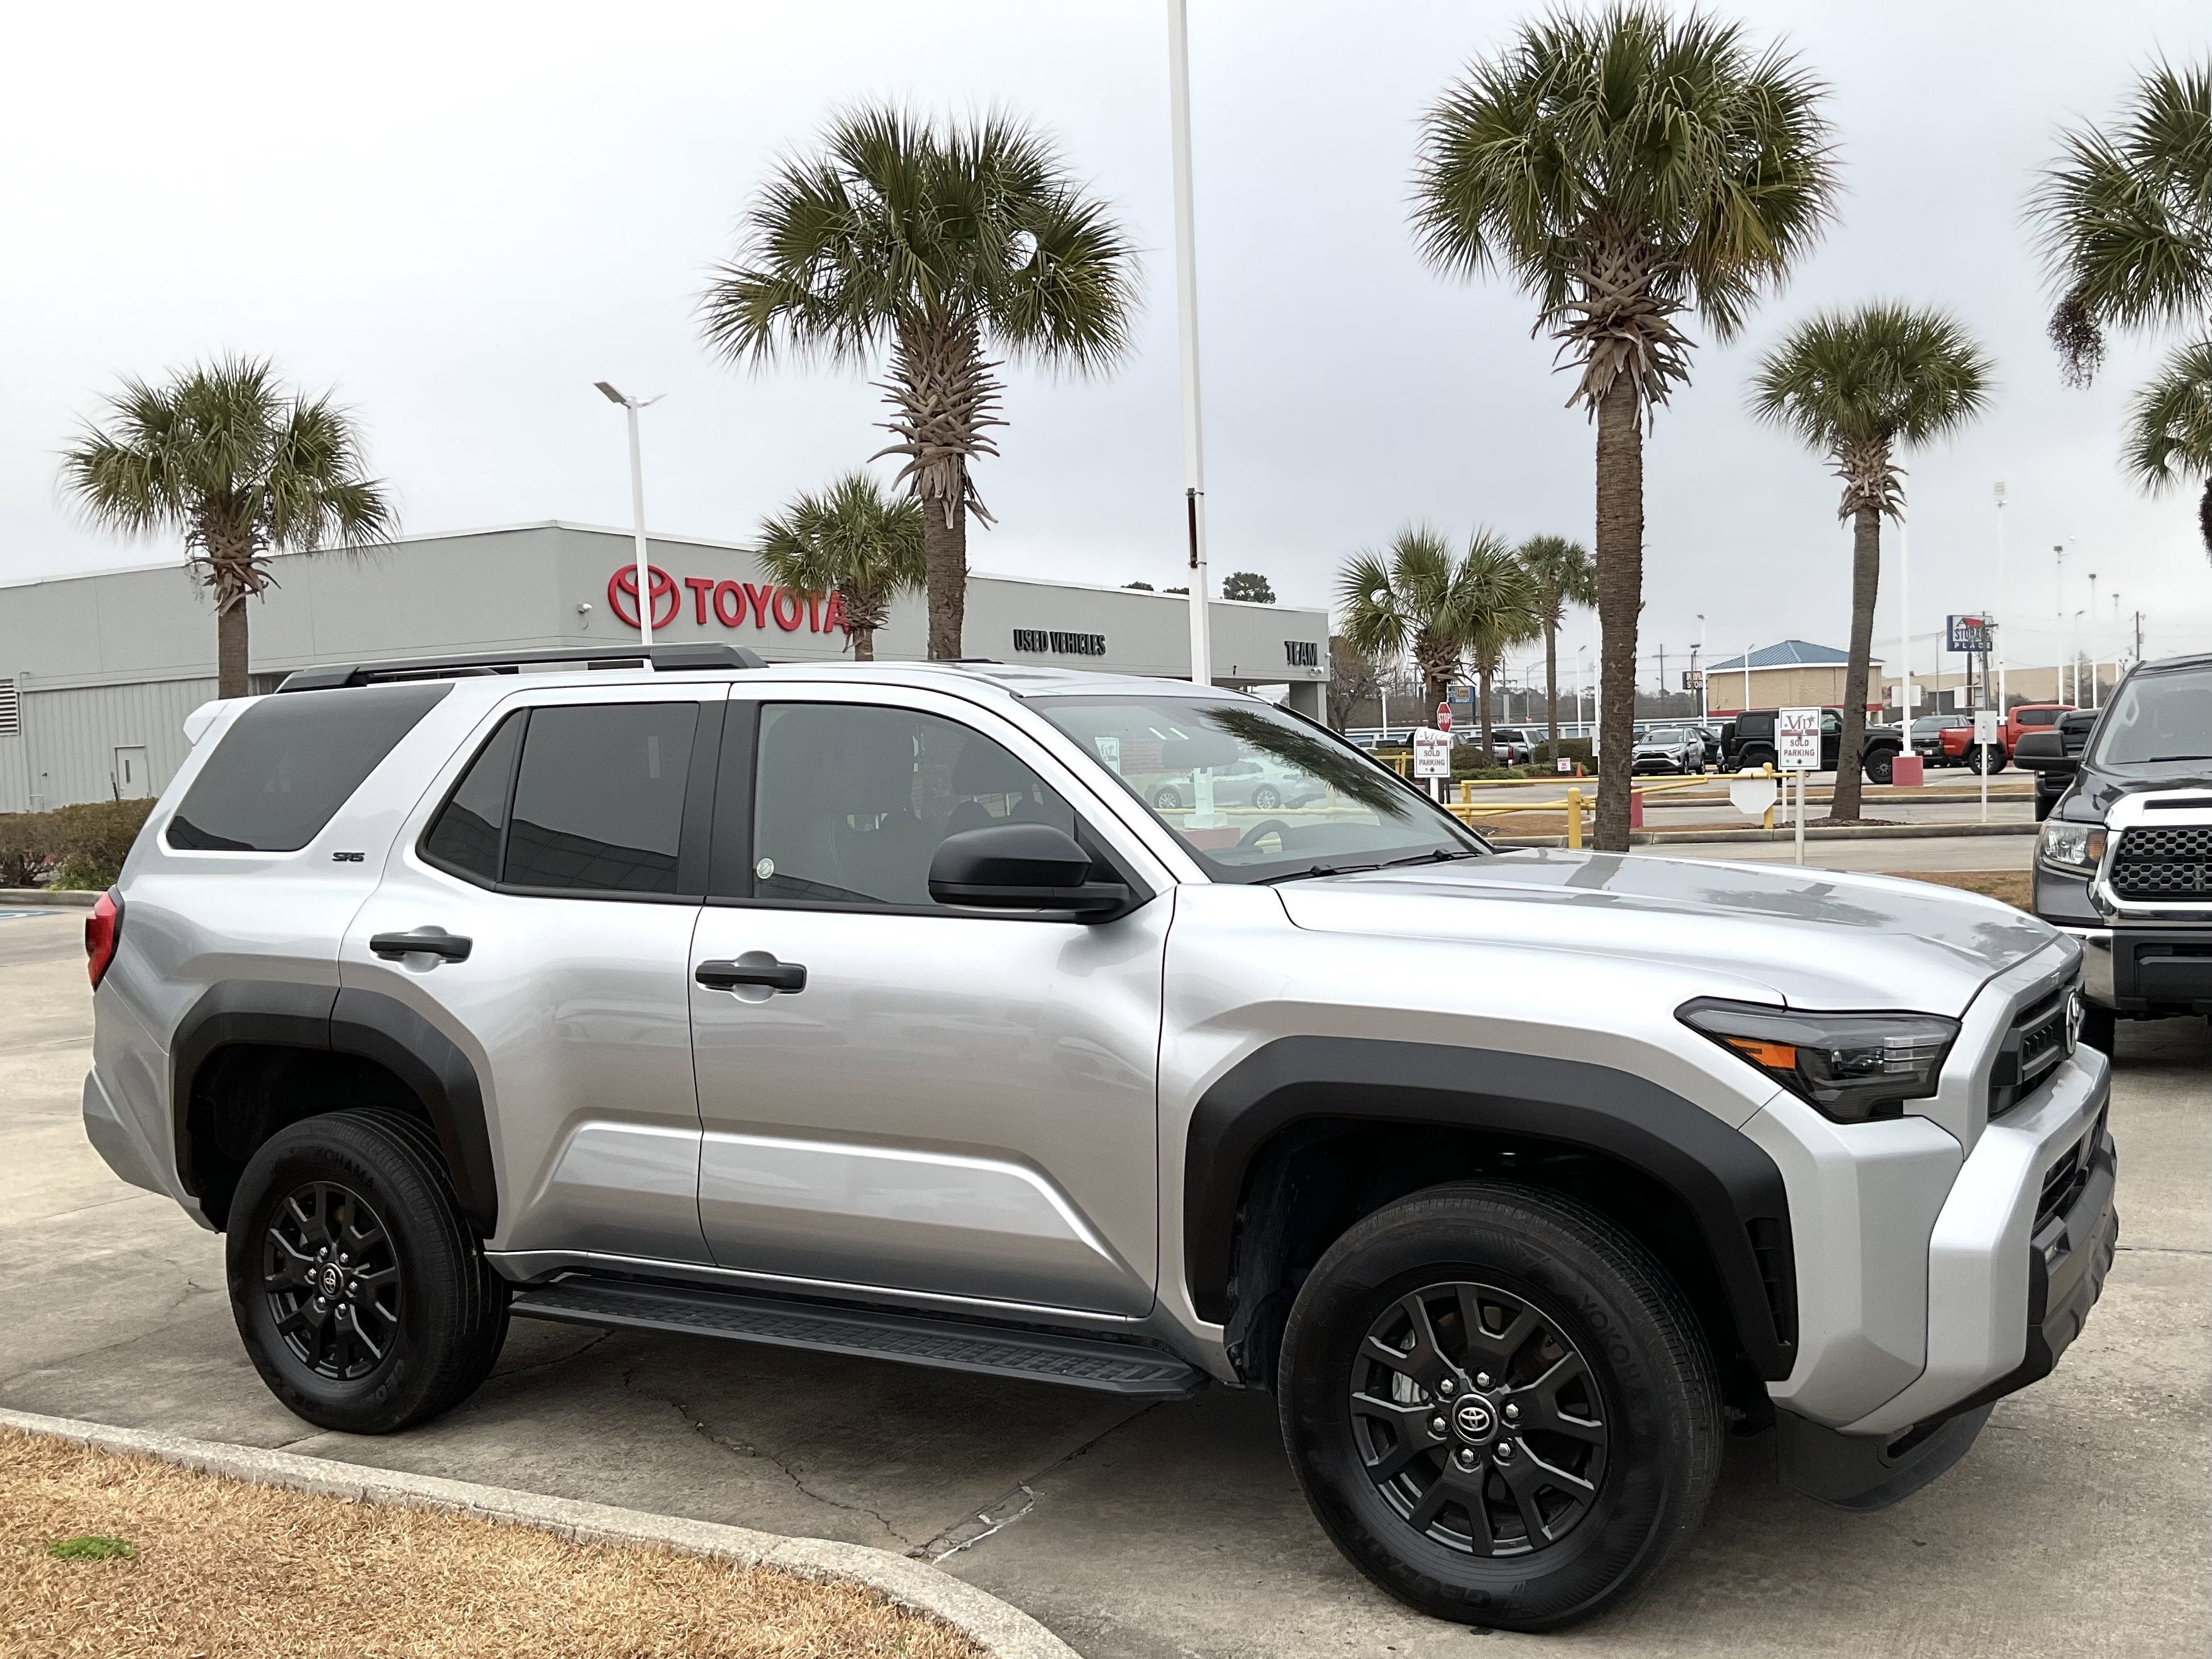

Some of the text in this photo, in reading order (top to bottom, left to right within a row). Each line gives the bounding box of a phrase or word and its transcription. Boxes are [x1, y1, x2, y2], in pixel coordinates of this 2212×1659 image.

[685, 577, 850, 634] TOYOTA
[1013, 629, 1106, 655] USED VEHICLES
[1955, 629, 1991, 641] STORAE
[1284, 641, 1318, 665] TEAM
[1438, 713, 1450, 724] STOP
[332, 852, 365, 862] SR5
